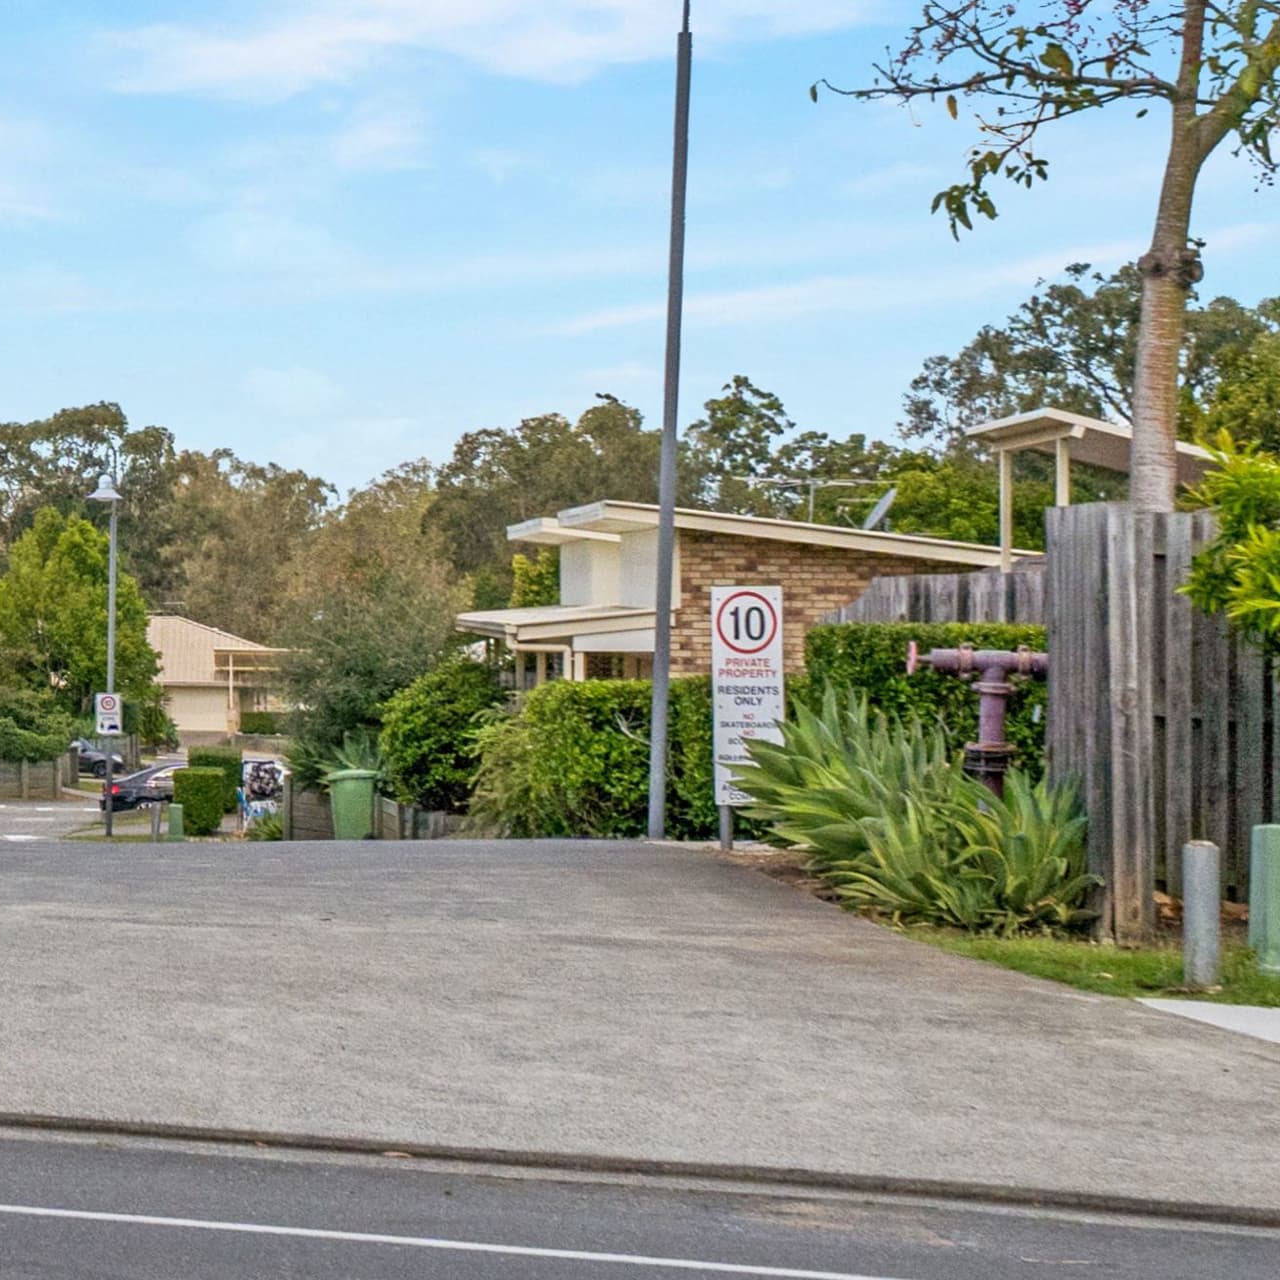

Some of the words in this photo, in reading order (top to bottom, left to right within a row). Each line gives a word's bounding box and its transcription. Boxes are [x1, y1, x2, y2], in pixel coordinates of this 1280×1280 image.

[729, 606, 766, 641] 10
[725, 657, 771, 668] PRIVATE
[718, 668, 777, 678] PROPERTY
[717, 685, 780, 696] RESIDENTS
[734, 696, 763, 706] ONLY
